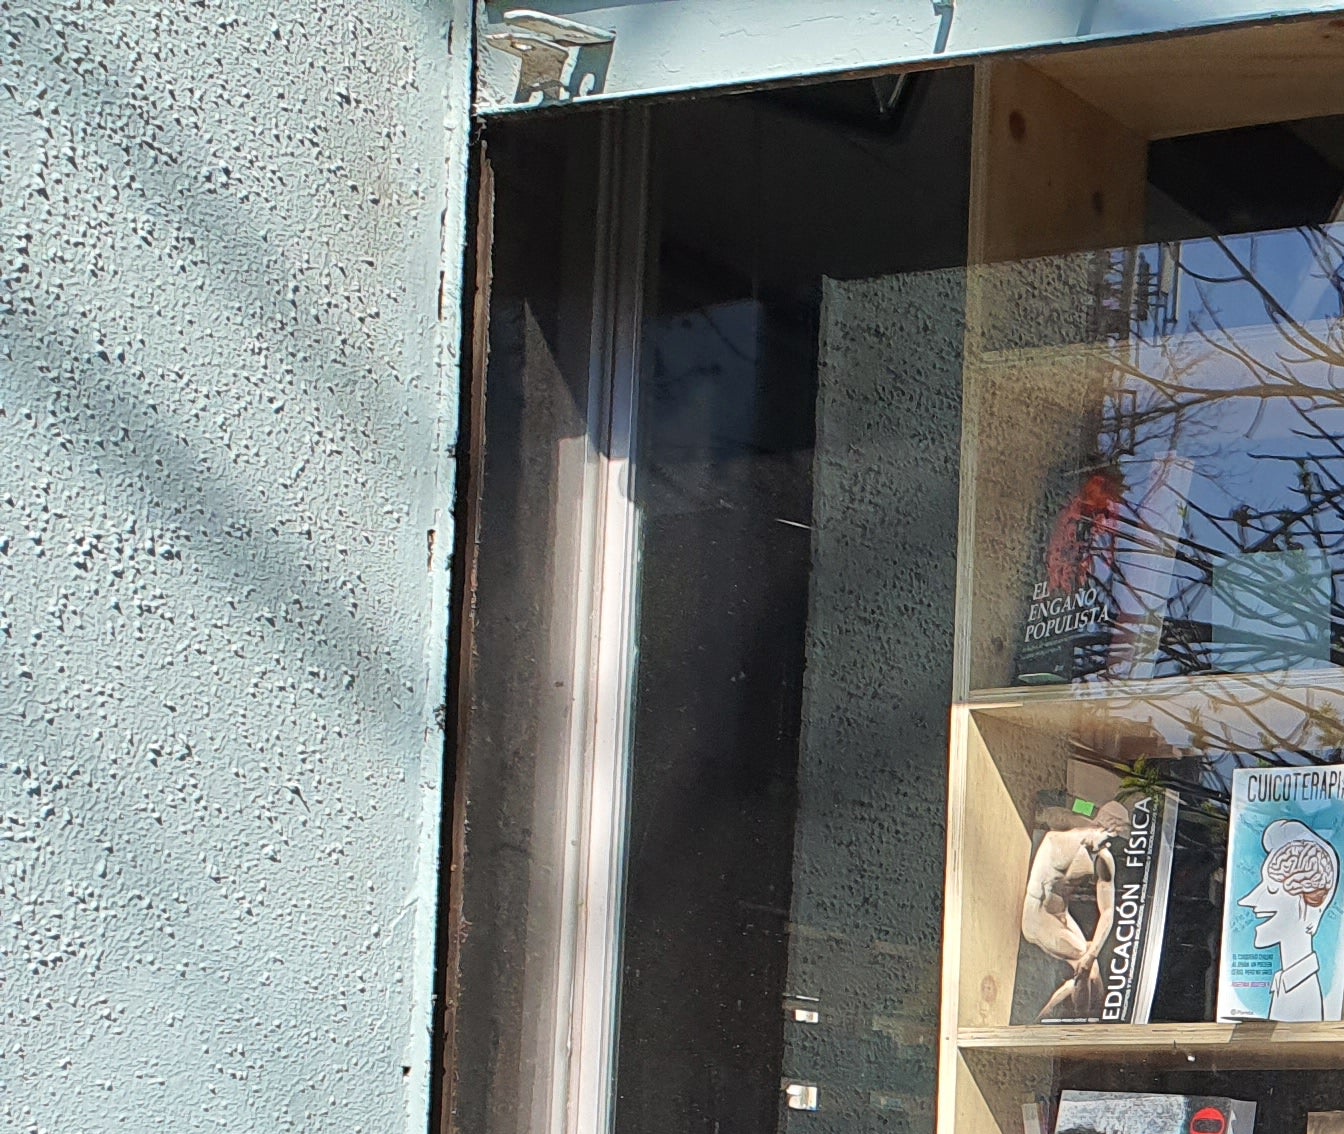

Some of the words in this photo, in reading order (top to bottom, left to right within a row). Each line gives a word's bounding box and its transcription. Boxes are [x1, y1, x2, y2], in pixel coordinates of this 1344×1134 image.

[1033, 581, 1050, 600] EL
[1024, 604, 1112, 643] POPULISTA
[1102, 884, 1140, 1021] EDUCACIÓN
[1124, 796, 1152, 868] FÍSICA
